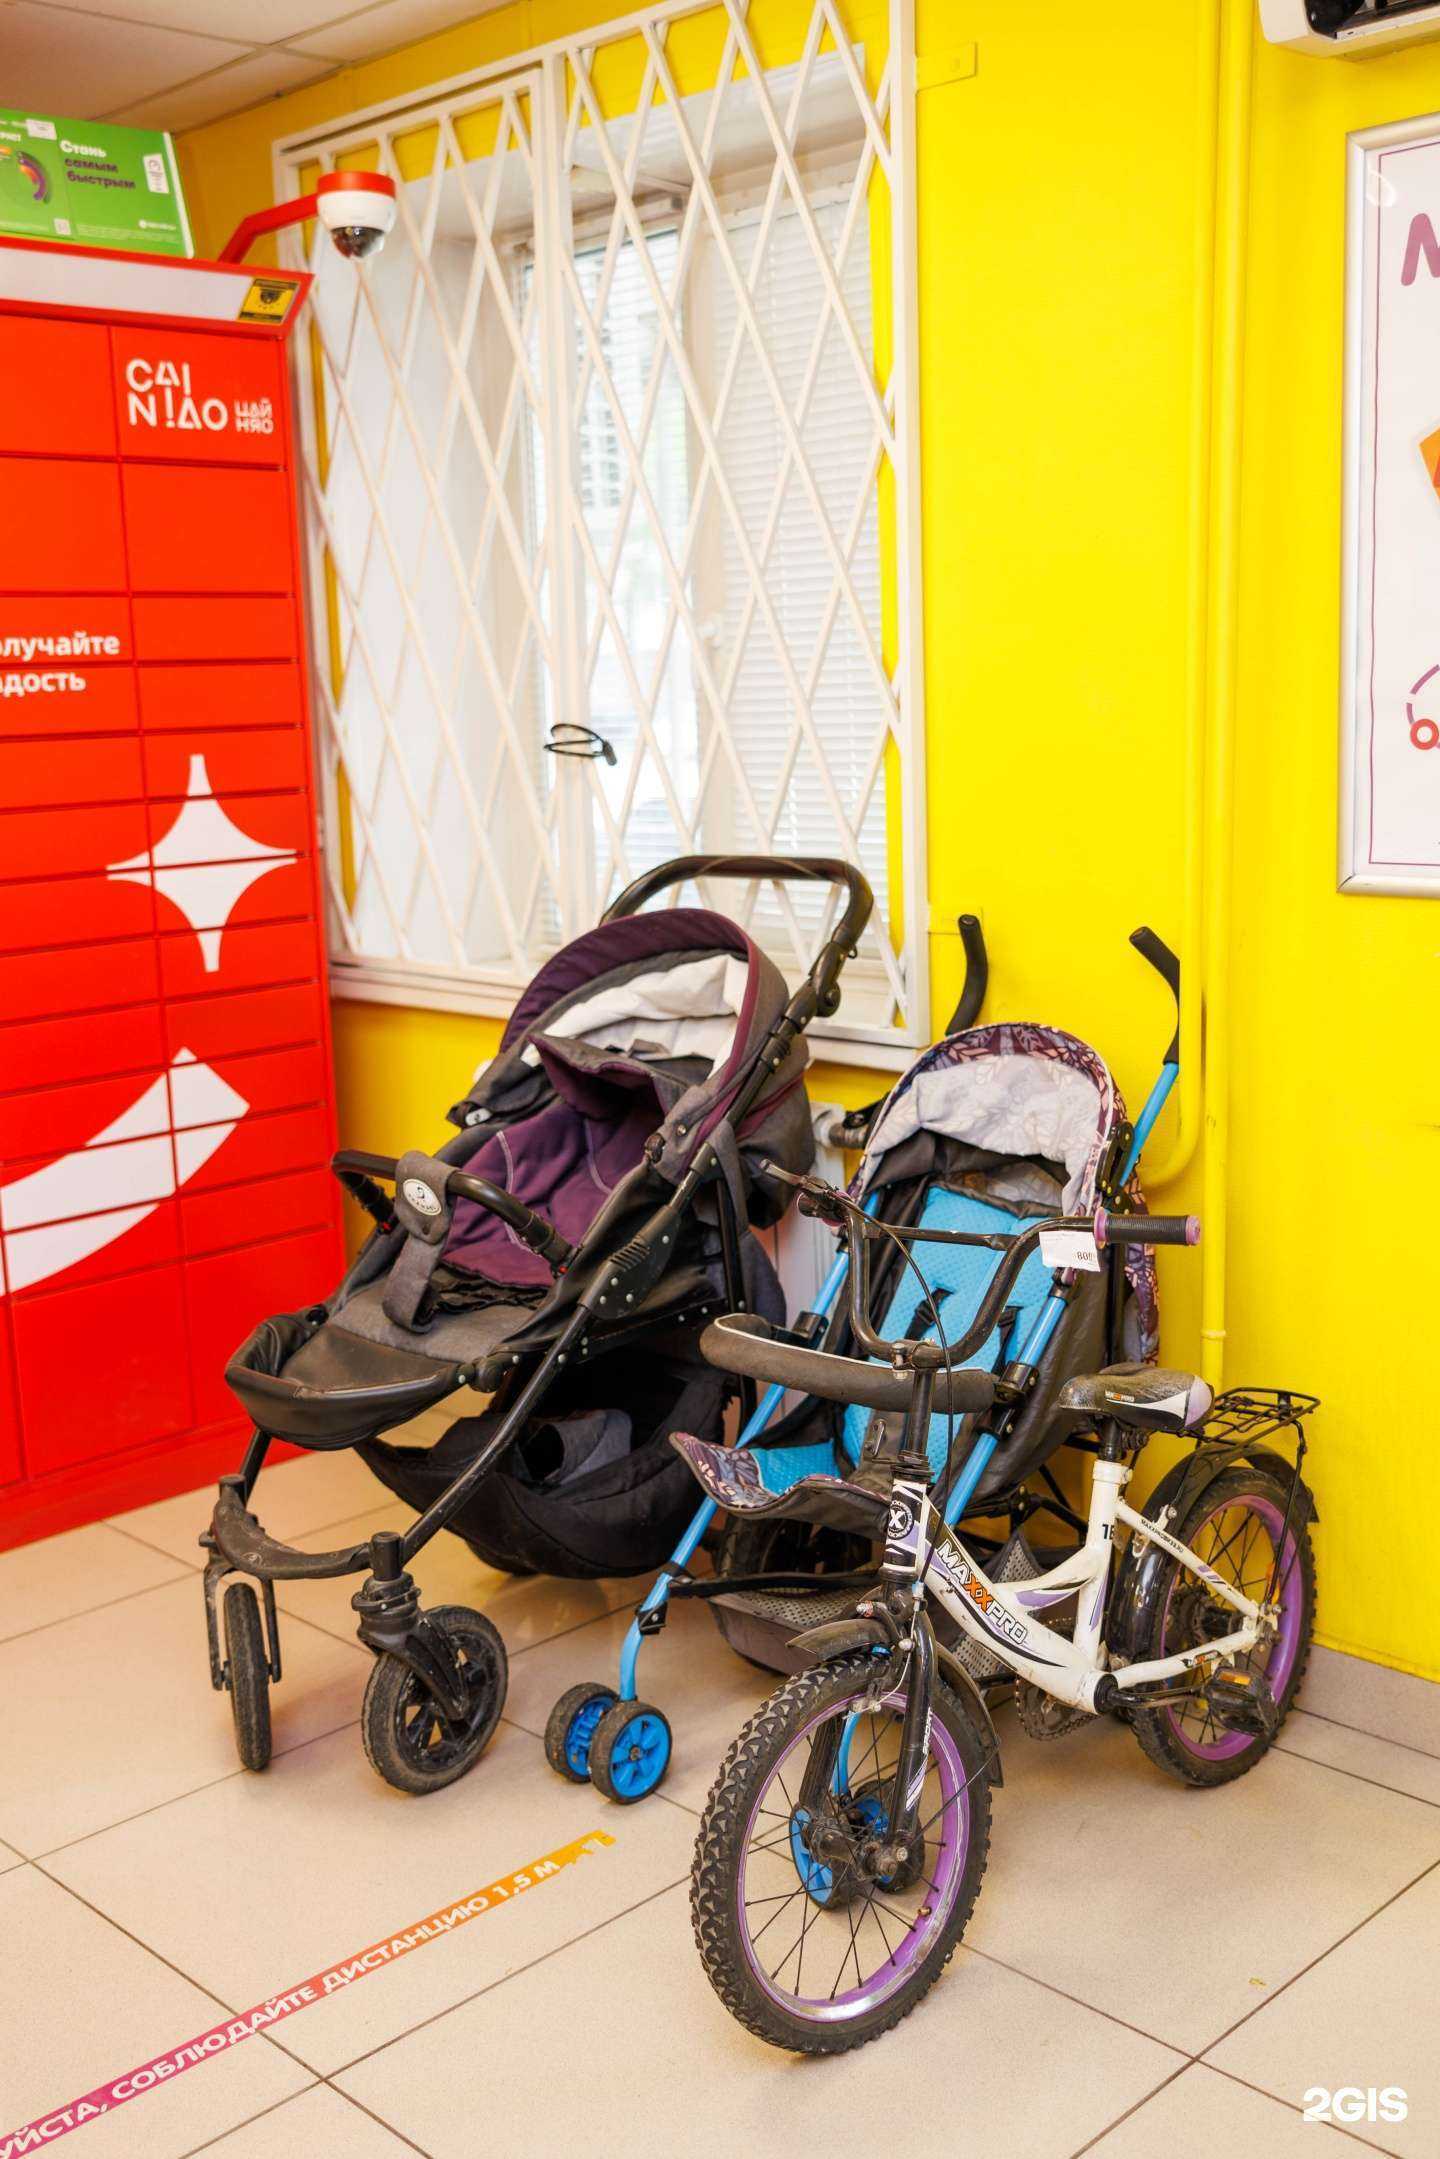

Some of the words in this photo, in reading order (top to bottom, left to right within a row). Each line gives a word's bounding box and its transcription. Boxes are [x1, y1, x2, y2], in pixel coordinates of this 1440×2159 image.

[60, 139, 107, 158] Стань
[64, 158, 118, 173] самым
[67, 171, 136, 190] быстрым
[0, 630, 121, 662] лучайте
[0, 672, 87, 698] дость
[937, 1538, 1028, 1645] MAXXPRO
[111, 1985, 318, 2100] СОБЛЮДАЙТЕ
[322, 1896, 489, 1994] ДИСТАНЦИЮ
[492, 1873, 532, 1896] 1,5
